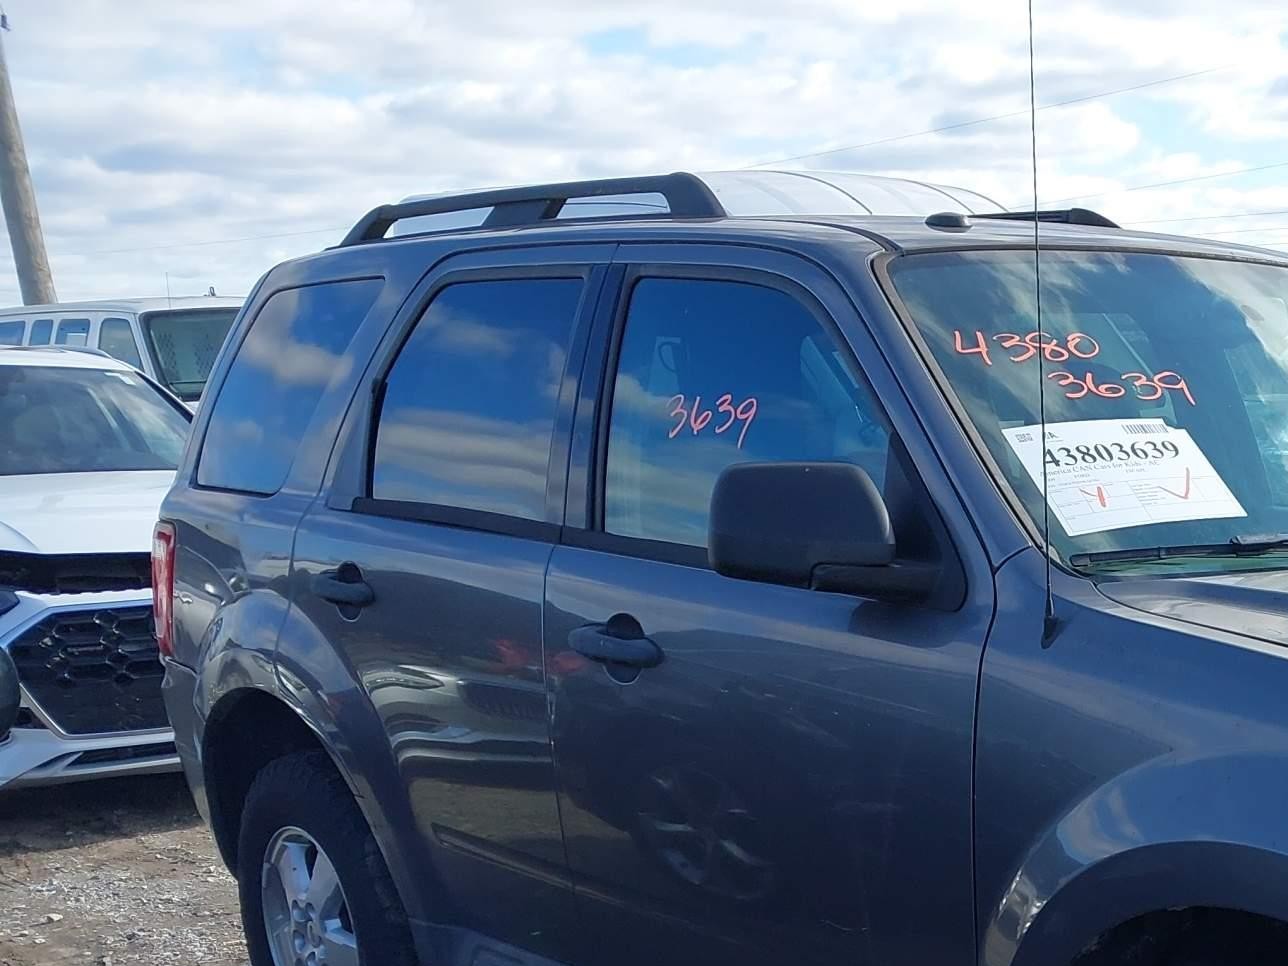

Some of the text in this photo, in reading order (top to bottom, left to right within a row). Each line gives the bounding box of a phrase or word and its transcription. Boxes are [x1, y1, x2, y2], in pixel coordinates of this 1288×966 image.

[953, 330, 1100, 366] 4380
[1048, 371, 1196, 406] 3639
[665, 393, 758, 449] 3639
[1043, 439, 1180, 468] 43803639
